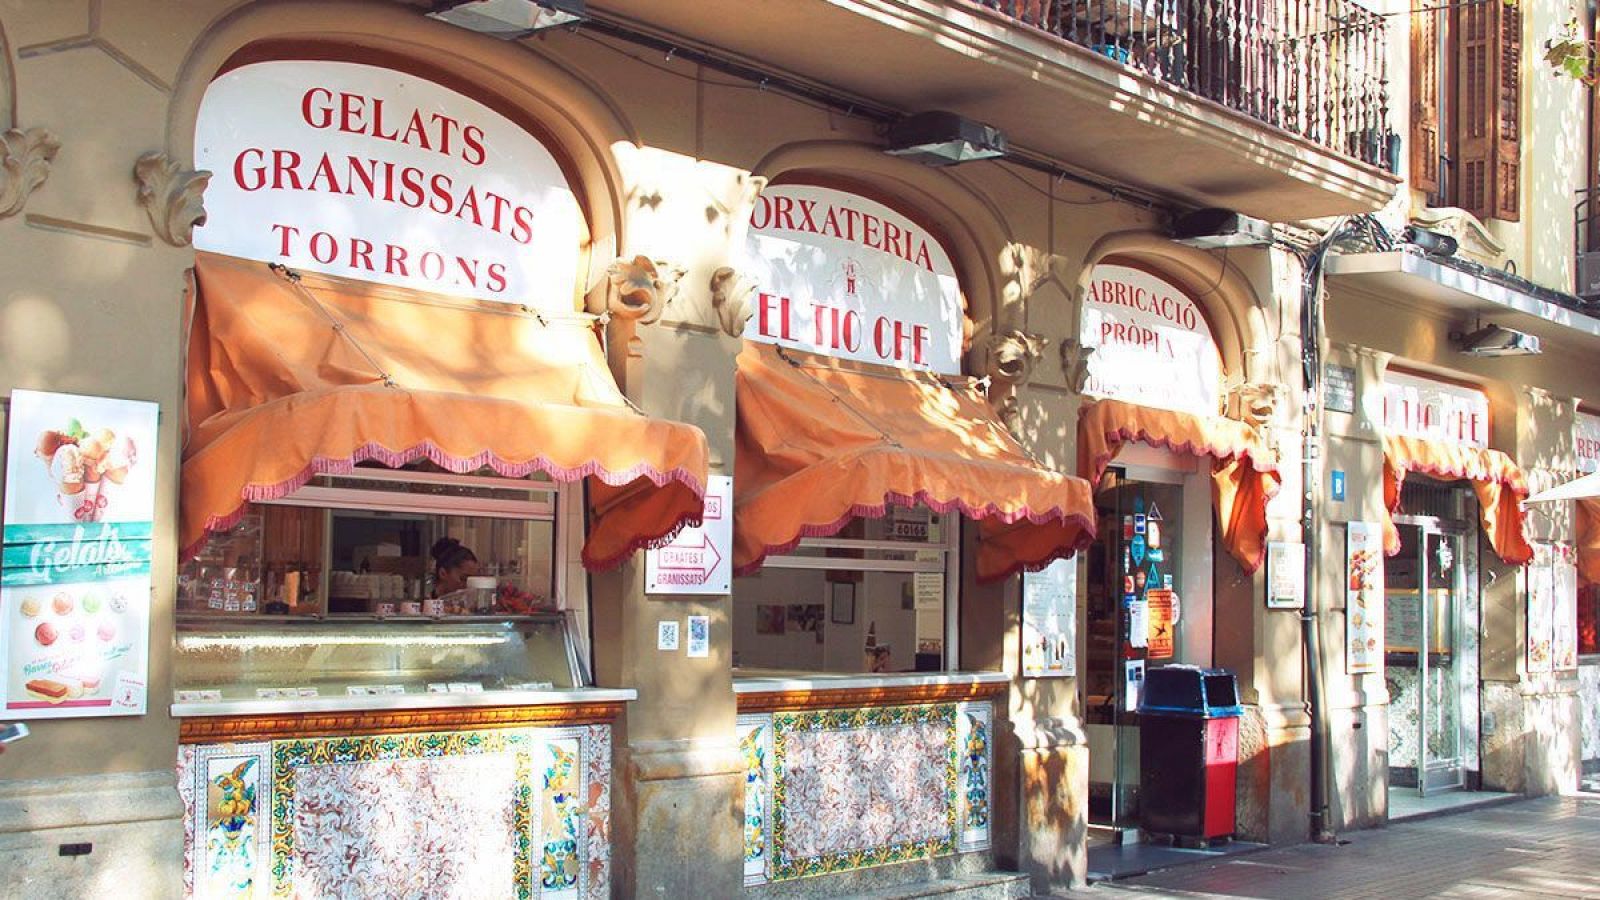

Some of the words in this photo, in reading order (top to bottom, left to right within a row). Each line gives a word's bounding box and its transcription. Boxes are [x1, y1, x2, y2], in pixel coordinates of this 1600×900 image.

[301, 87, 487, 166] GELATS
[233, 147, 535, 245] GRANISSATS
[272, 224, 507, 293] TORRONS
[750, 195, 934, 273] ORXATERIA
[758, 292, 799, 342] EL
[810, 303, 862, 353] TIO
[874, 316, 929, 366] CHE
[1335, 478, 1342, 495] B
[657, 573, 705, 586] GRANISSATS
